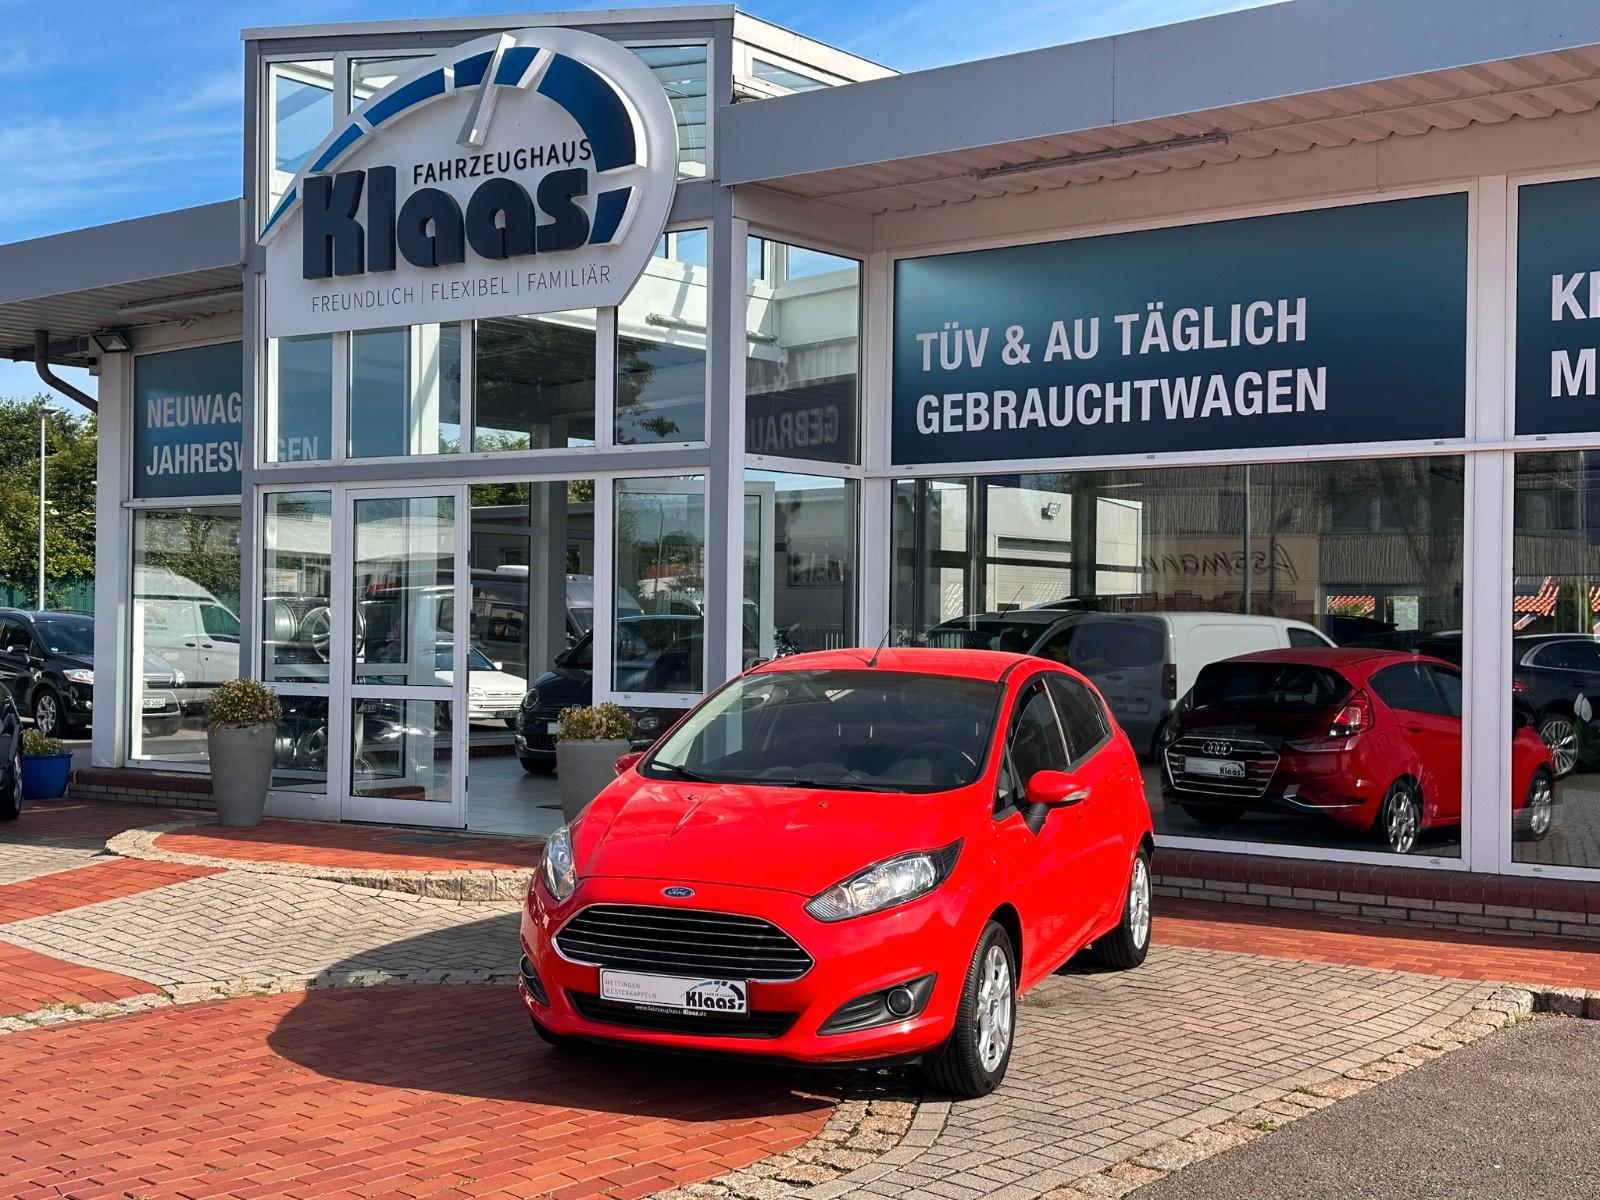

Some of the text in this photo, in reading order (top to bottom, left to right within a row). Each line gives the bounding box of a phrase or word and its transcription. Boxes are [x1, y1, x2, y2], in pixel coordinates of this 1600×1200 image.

[413, 138, 592, 185] FAHRZEUGHAUS
[303, 165, 590, 280] Klaas
[311, 264, 611, 313] FREUNDLICH FLEXIBEL FAMILIÄR
[915, 297, 1306, 372] TÜV & AU TÄGLICH
[146, 392, 242, 429] NEUWAG
[916, 366, 1327, 435] GEBRAUCHTWAGEN
[686, 990, 737, 1010] Klaas
